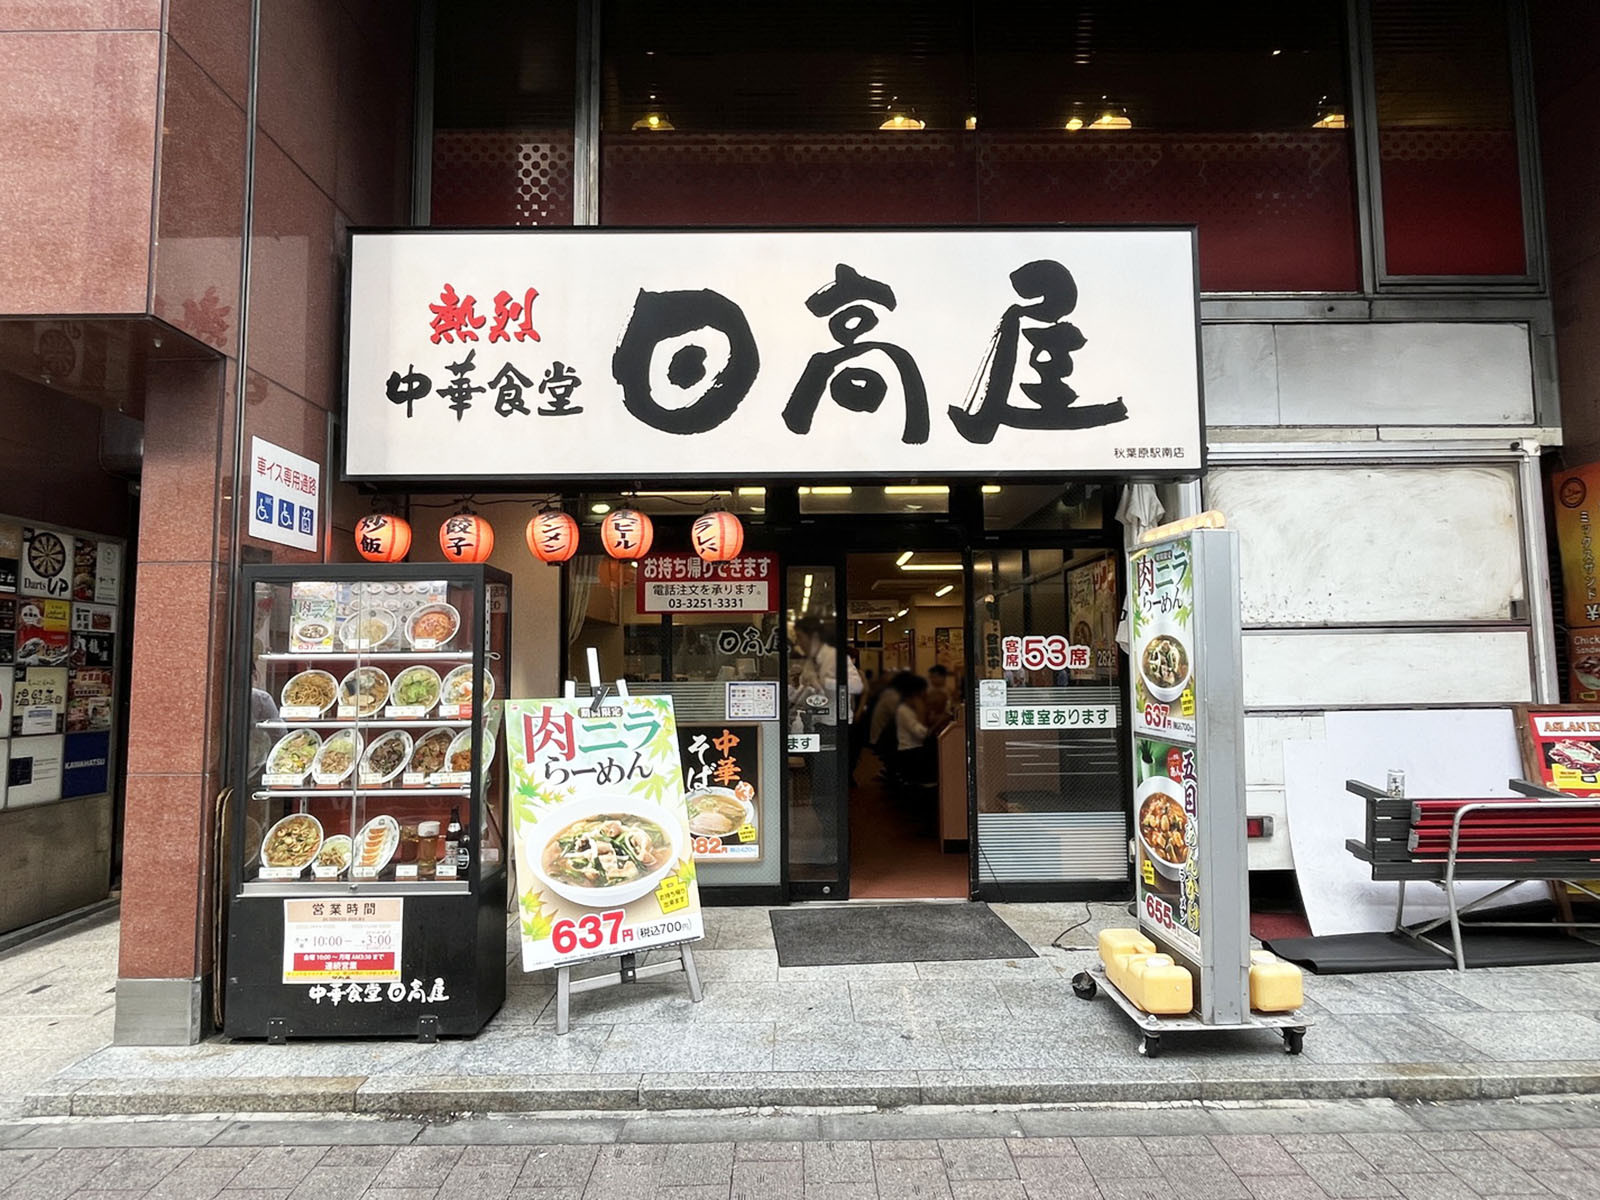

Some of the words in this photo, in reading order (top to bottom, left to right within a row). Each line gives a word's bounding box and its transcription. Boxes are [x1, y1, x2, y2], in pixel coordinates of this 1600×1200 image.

[429, 283, 541, 345] 熱烈
[612, 259, 1129, 445] 日高屋
[386, 349, 584, 422] 中華食堂
[1113, 446, 1186, 460] 秋葉原駅南店
[256, 456, 317, 497] 車イス専用通路
[359, 514, 388, 554] 炒飯
[446, 517, 475, 557] 餃子
[644, 557, 771, 579] お持ち帰りできます
[1137, 551, 1188, 596] 肉ニラ
[652, 584, 762, 596] 電話注文を承ります。
[668, 599, 743, 608] 03-3251-3331
[1143, 587, 1183, 613] らーめん
[523, 705, 661, 764] 肉ニラ
[1005, 709, 1109, 726] 喫煙室あります
[1544, 721, 1586, 733] ASLAN
[544, 752, 654, 786] らーめん
[687, 734, 717, 793] そば
[712, 729, 742, 785] 中華
[312, 903, 376, 915] 営業時間
[552, 910, 634, 954] 637円
[309, 982, 383, 1006] 中華食堂
[387, 977, 450, 1003] 日高屋
